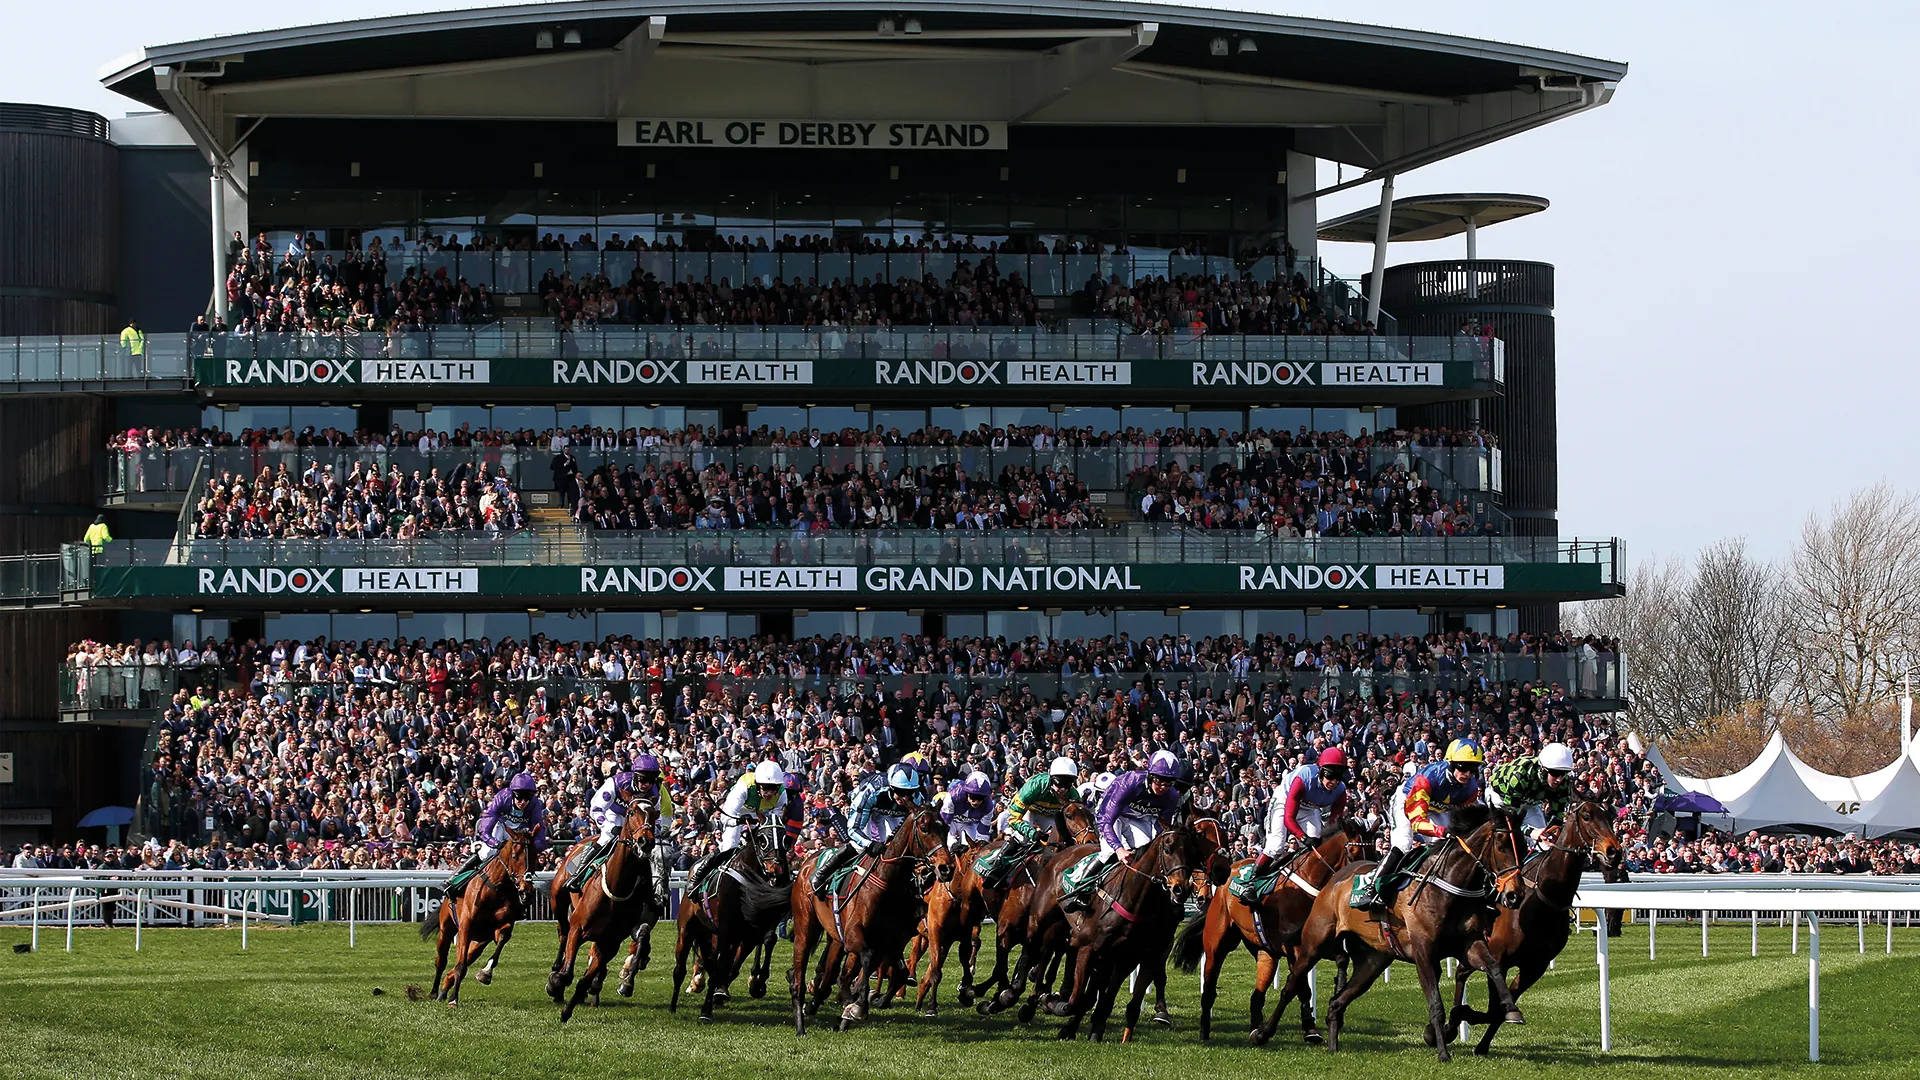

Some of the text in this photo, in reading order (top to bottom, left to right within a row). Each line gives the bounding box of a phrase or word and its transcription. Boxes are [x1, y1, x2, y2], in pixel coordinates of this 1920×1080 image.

[635, 121, 990, 147] EARL OF DERBY STAND
[226, 360, 474, 383] RANDOX HEALTH
[553, 360, 798, 384] RANDOX HEALTH
[875, 360, 1117, 385] RANDOX HEALTH
[1192, 361, 1430, 386] RANDOX HEALTH
[198, 568, 462, 593] RANDOX HEALTH
[581, 566, 1141, 592] RANDOX HEALTH GRAND NATIONAL
[1240, 564, 1489, 590] RANDOX HEALTH
[230, 888, 331, 909] RANDOX
